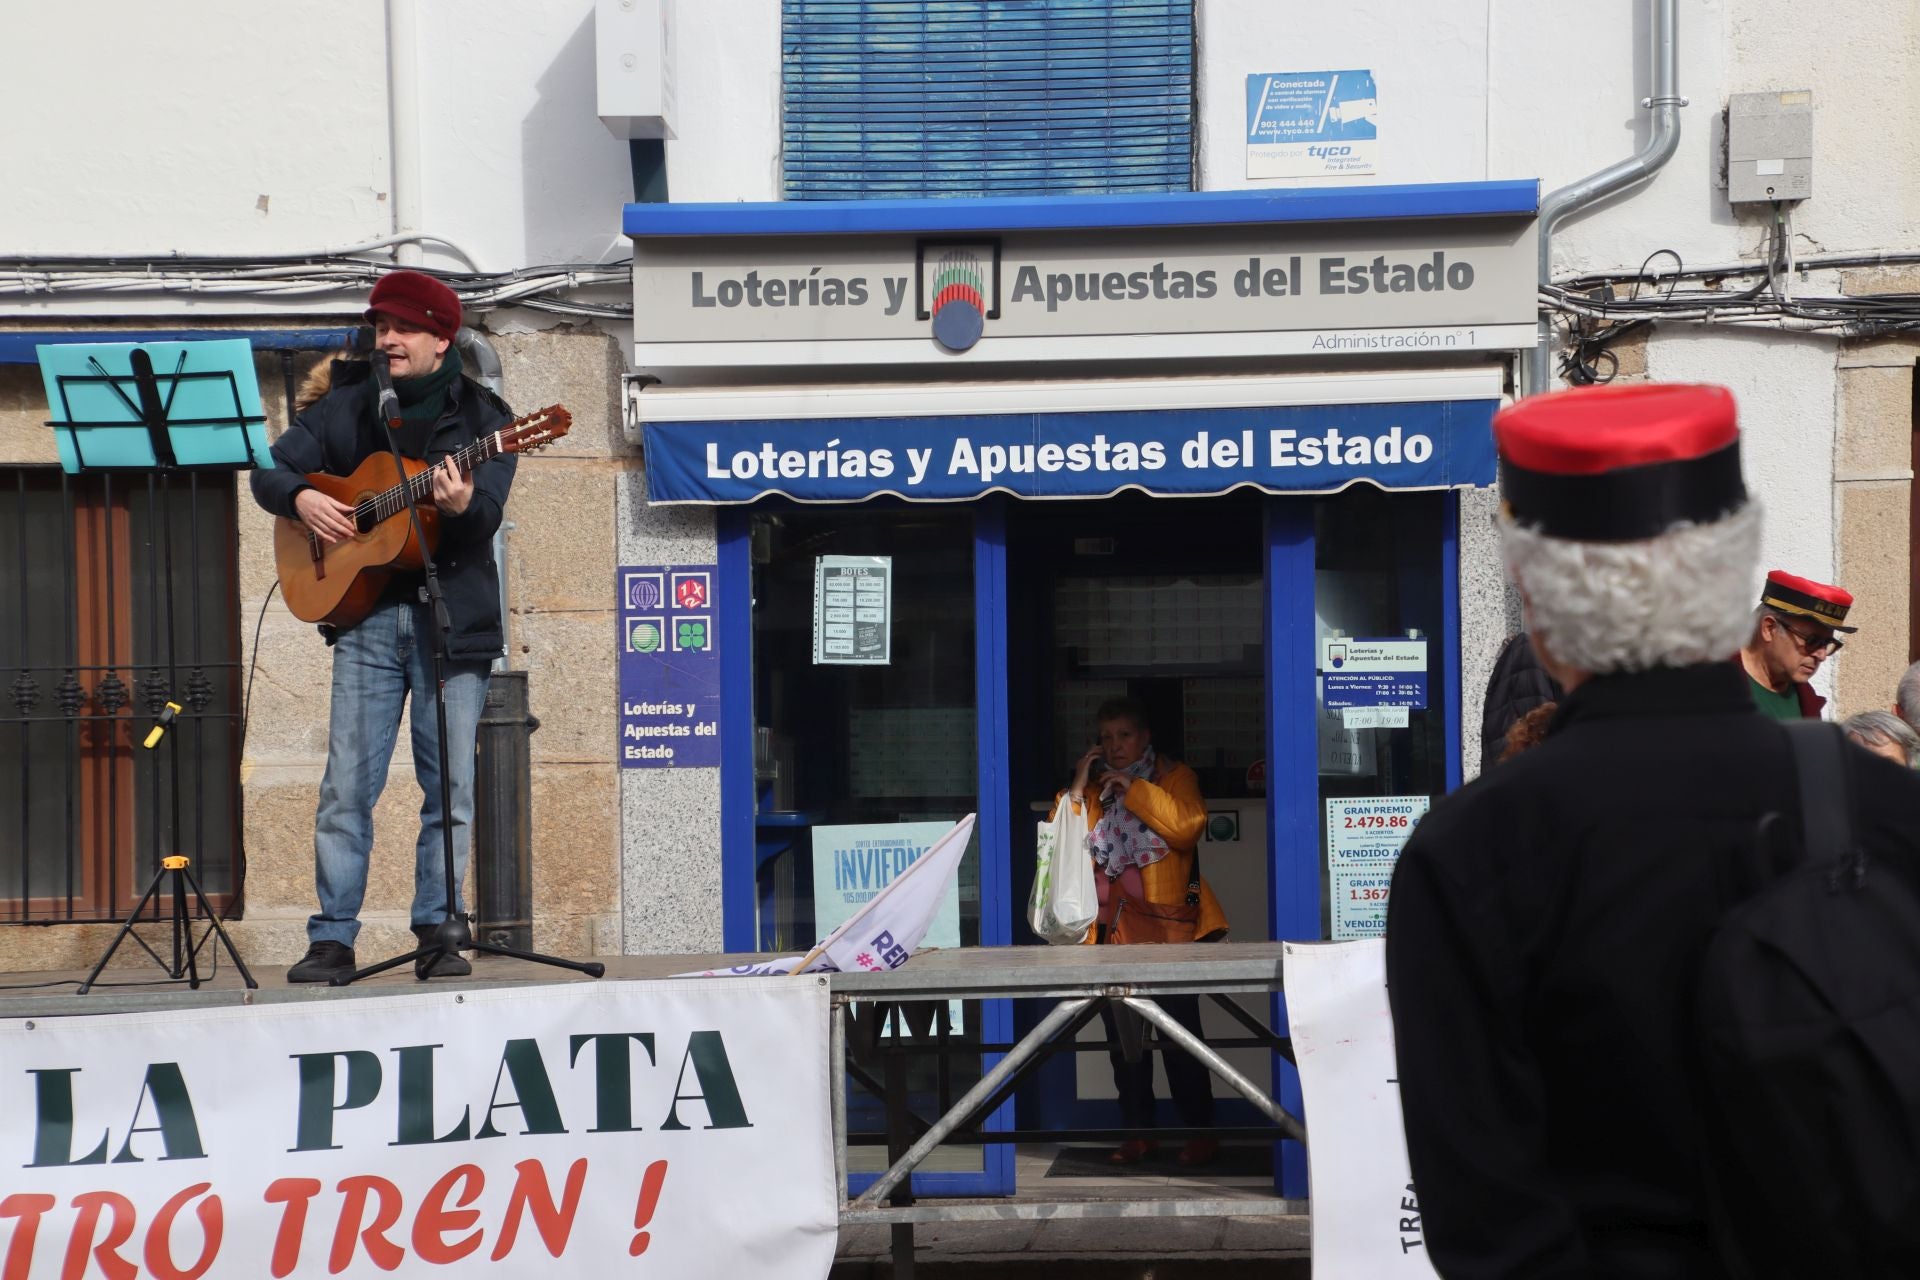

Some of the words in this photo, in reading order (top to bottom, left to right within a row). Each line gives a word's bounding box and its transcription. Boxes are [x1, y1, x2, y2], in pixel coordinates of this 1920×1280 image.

[1273, 80, 1325, 88] Conectada
[1261, 120, 1277, 128] 902
[1250, 150, 1288, 159] Protegido
[1290, 150, 1303, 158] por
[1307, 145, 1352, 159] tyco
[691, 267, 868, 310] Loterías
[883, 278, 907, 316] y
[1011, 260, 1217, 312] Apuestas
[1233, 254, 1300, 297] del
[1317, 251, 1474, 295] Estado
[1312, 329, 1440, 350] Administración
[1467, 330, 1476, 346] 1
[705, 437, 893, 480] Loterías
[905, 446, 932, 486] y
[948, 432, 1167, 480] Apuestas
[1182, 428, 1256, 469] del
[1269, 425, 1434, 468] Estado
[840, 567, 869, 576] BOTES
[624, 701, 683, 716] Loterías
[686, 704, 696, 717] y
[624, 723, 690, 740] Apuestas
[694, 722, 717, 736] del
[625, 745, 674, 759] Estado
[1344, 806, 1371, 815] GRAN
[1374, 806, 1413, 814] PREMIO
[1344, 816, 1408, 829] 2.479.86
[1338, 849, 1390, 858] VENDIDO
[1349, 879, 1376, 887] GRAN
[1350, 889, 1389, 900] 1.367
[23, 1062, 208, 1168] LA
[287, 1030, 754, 1154] PLATA
[264, 1157, 588, 1279] TREN
[1399, 1177, 1424, 1255] TRE
